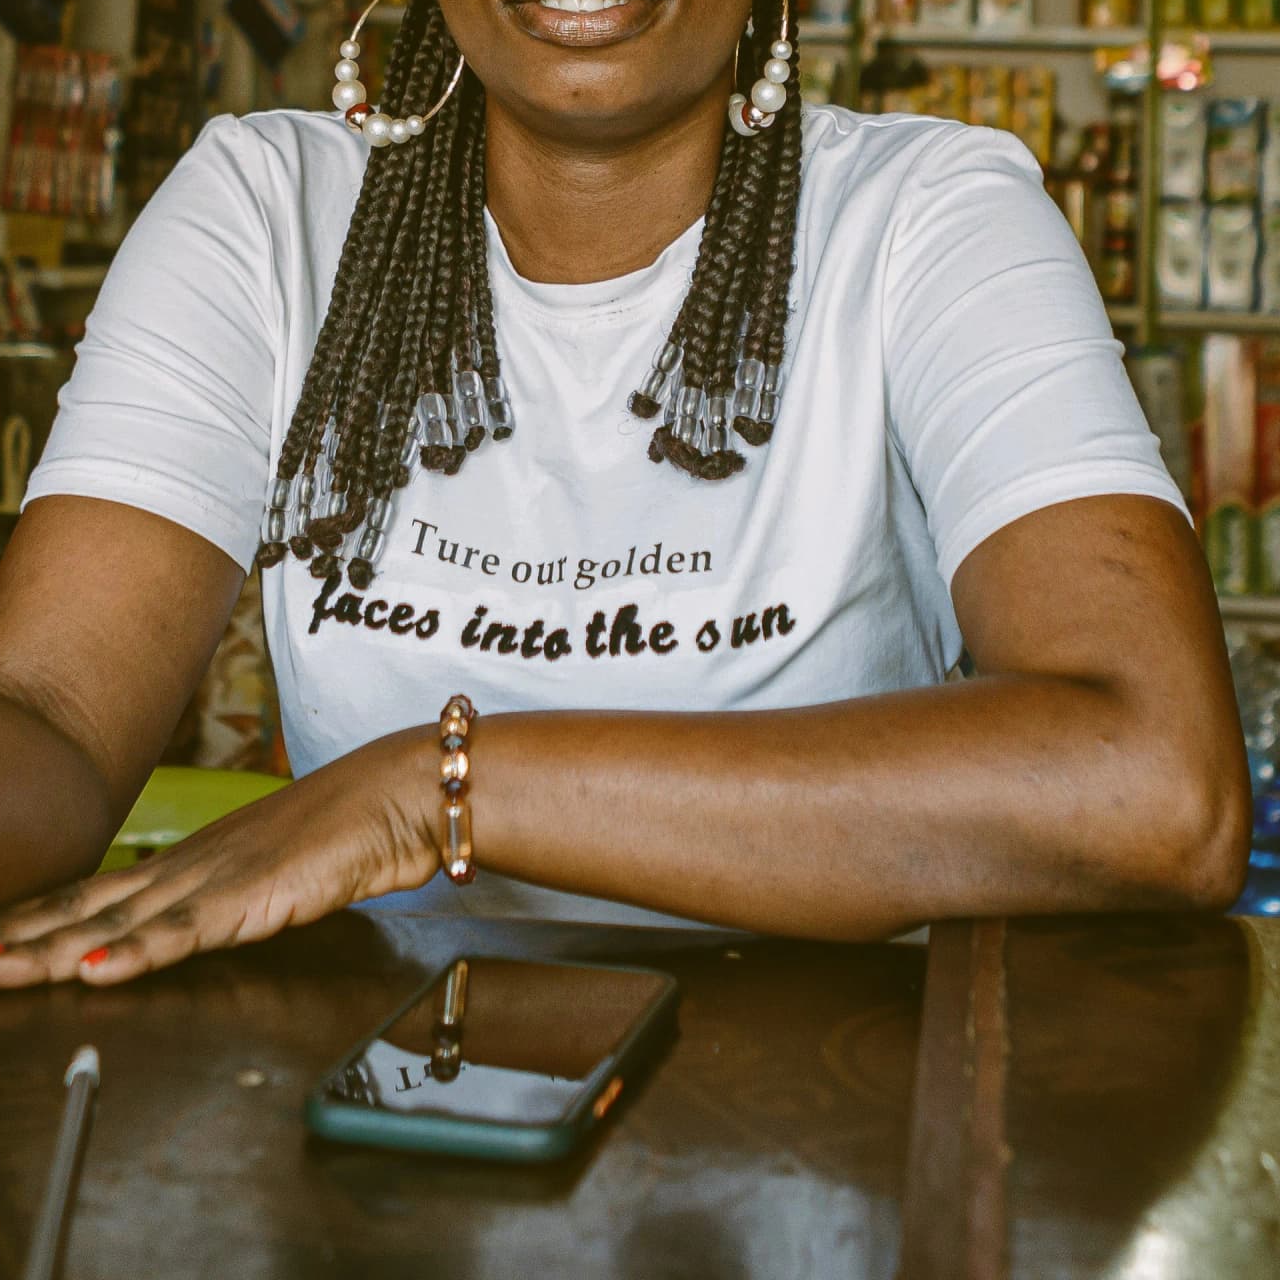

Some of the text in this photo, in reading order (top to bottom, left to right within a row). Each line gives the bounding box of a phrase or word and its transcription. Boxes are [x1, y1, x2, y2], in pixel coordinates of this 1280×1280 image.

[411, 518, 714, 592] Ture our golden
[307, 575, 441, 640] faces
[460, 604, 572, 662] into
[585, 603, 679, 660] the
